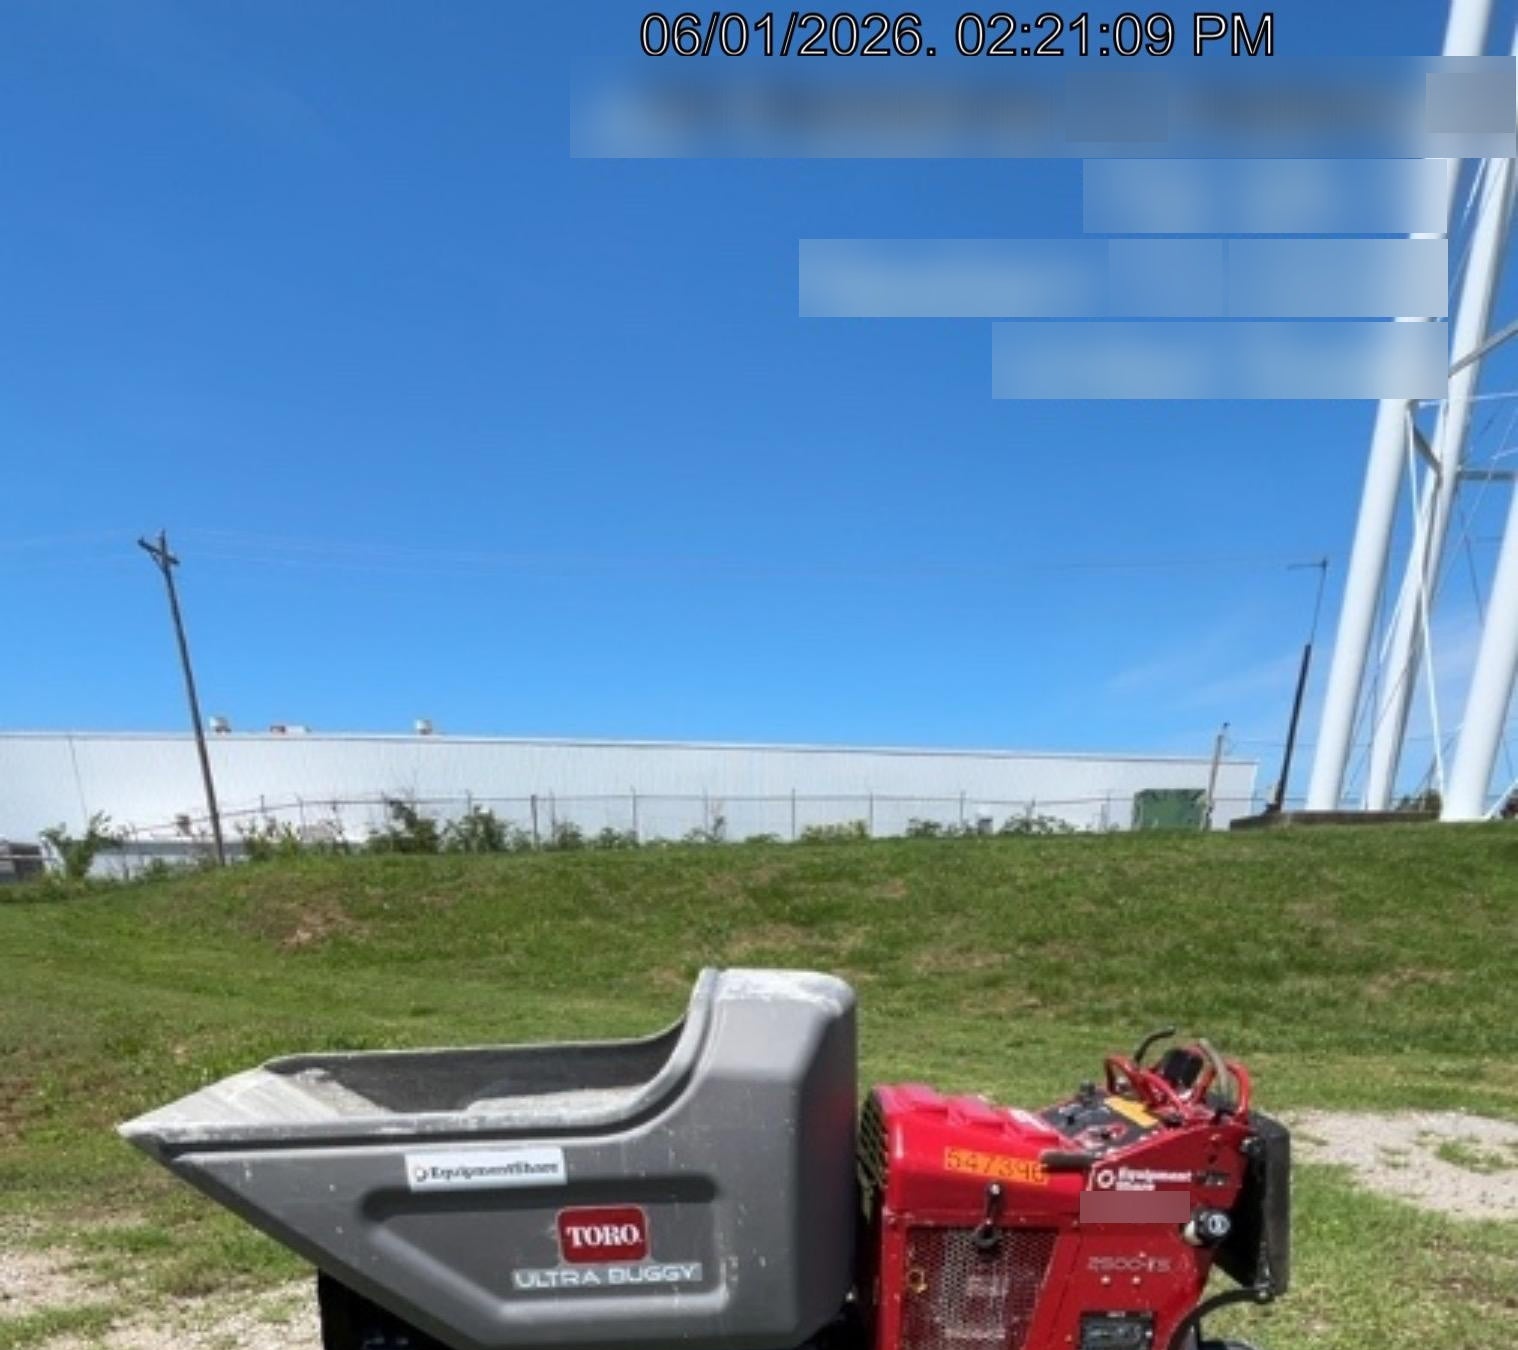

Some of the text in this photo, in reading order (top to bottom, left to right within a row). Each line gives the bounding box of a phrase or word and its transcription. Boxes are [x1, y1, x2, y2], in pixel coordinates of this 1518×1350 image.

[566, 1223, 640, 1247] TORO
[513, 1263, 698, 1289] ULTRA BUGGY
